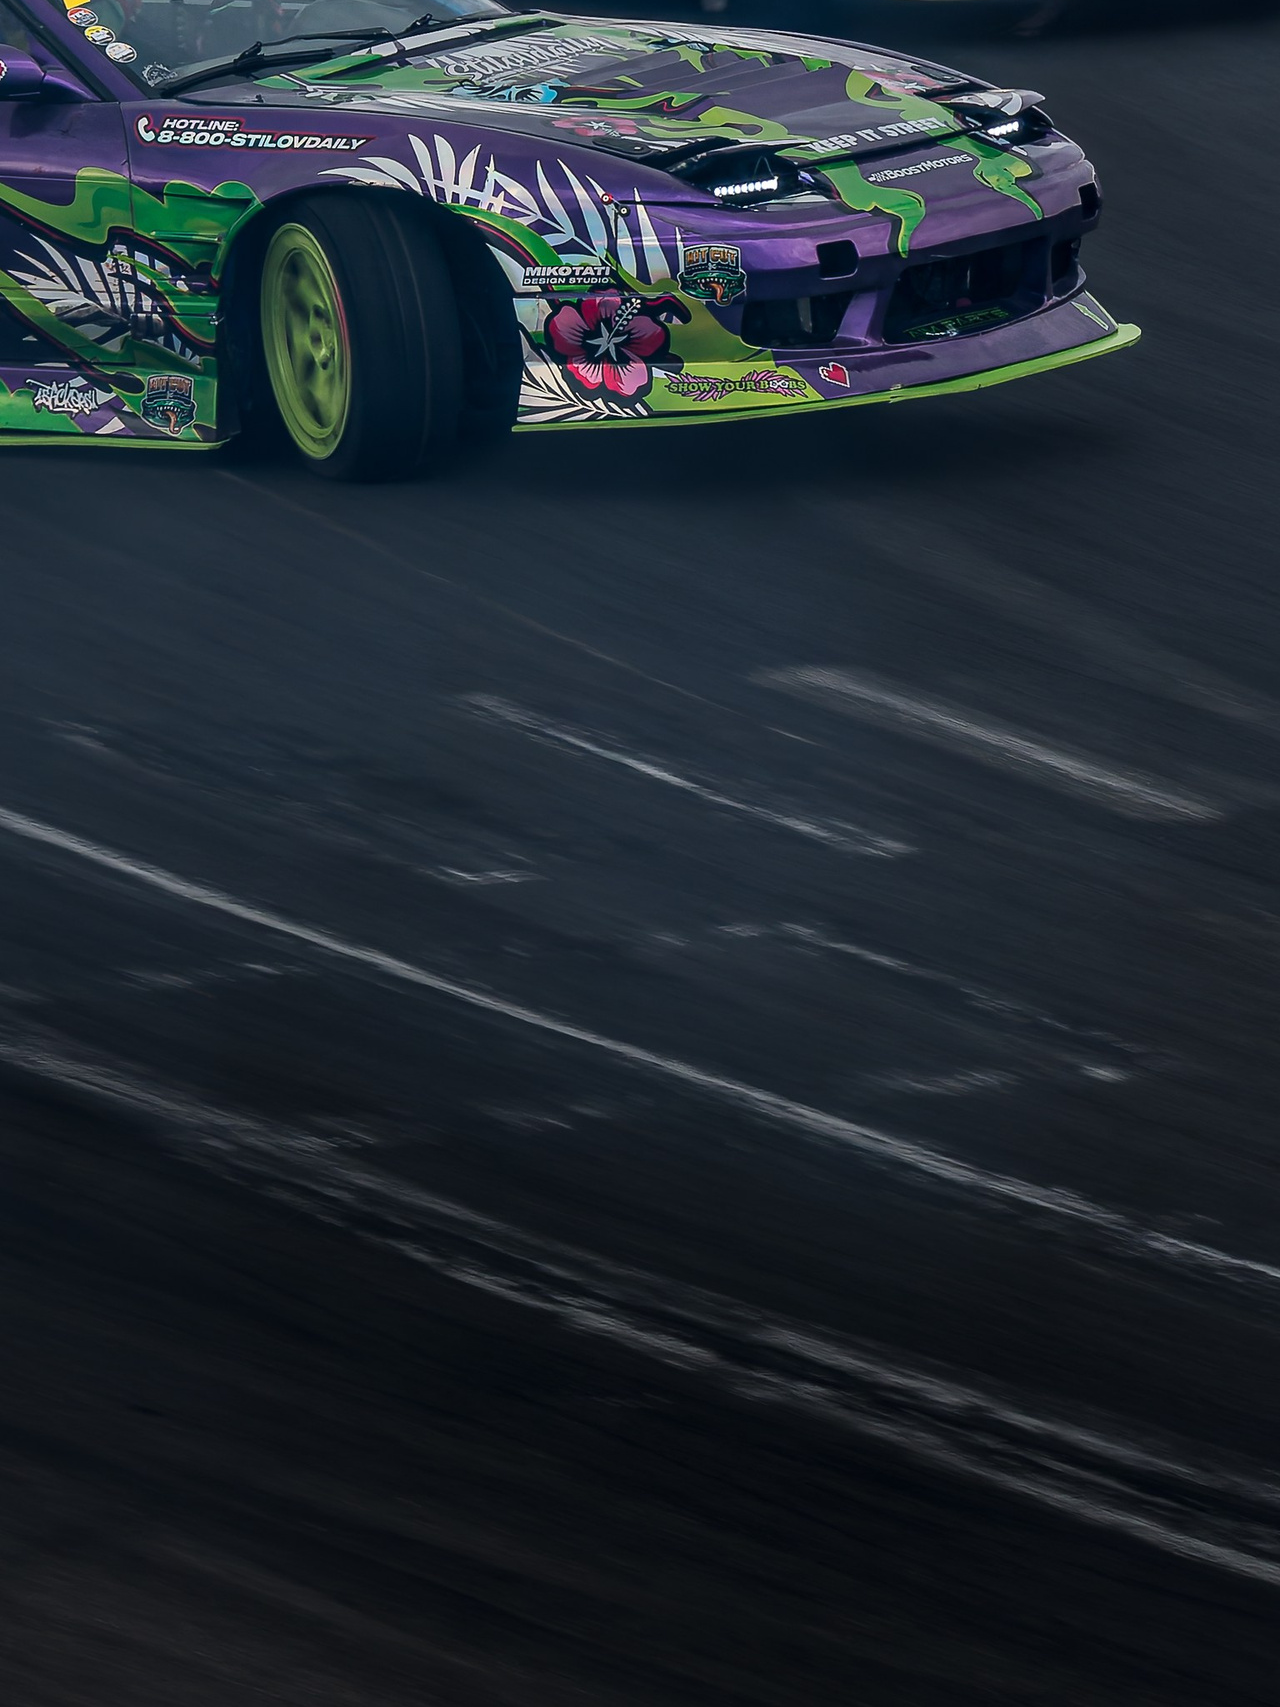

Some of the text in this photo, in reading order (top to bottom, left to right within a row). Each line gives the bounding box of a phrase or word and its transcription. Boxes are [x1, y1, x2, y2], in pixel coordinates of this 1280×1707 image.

[163, 118, 240, 131] HOTLINE:
[157, 131, 367, 150] 8-800-STILOVDAILY
[808, 117, 946, 154] KEEP IT STREET
[524, 266, 611, 277] MIKOTATI
[670, 382, 713, 393] SHOW
[717, 380, 757, 392] YOUR
